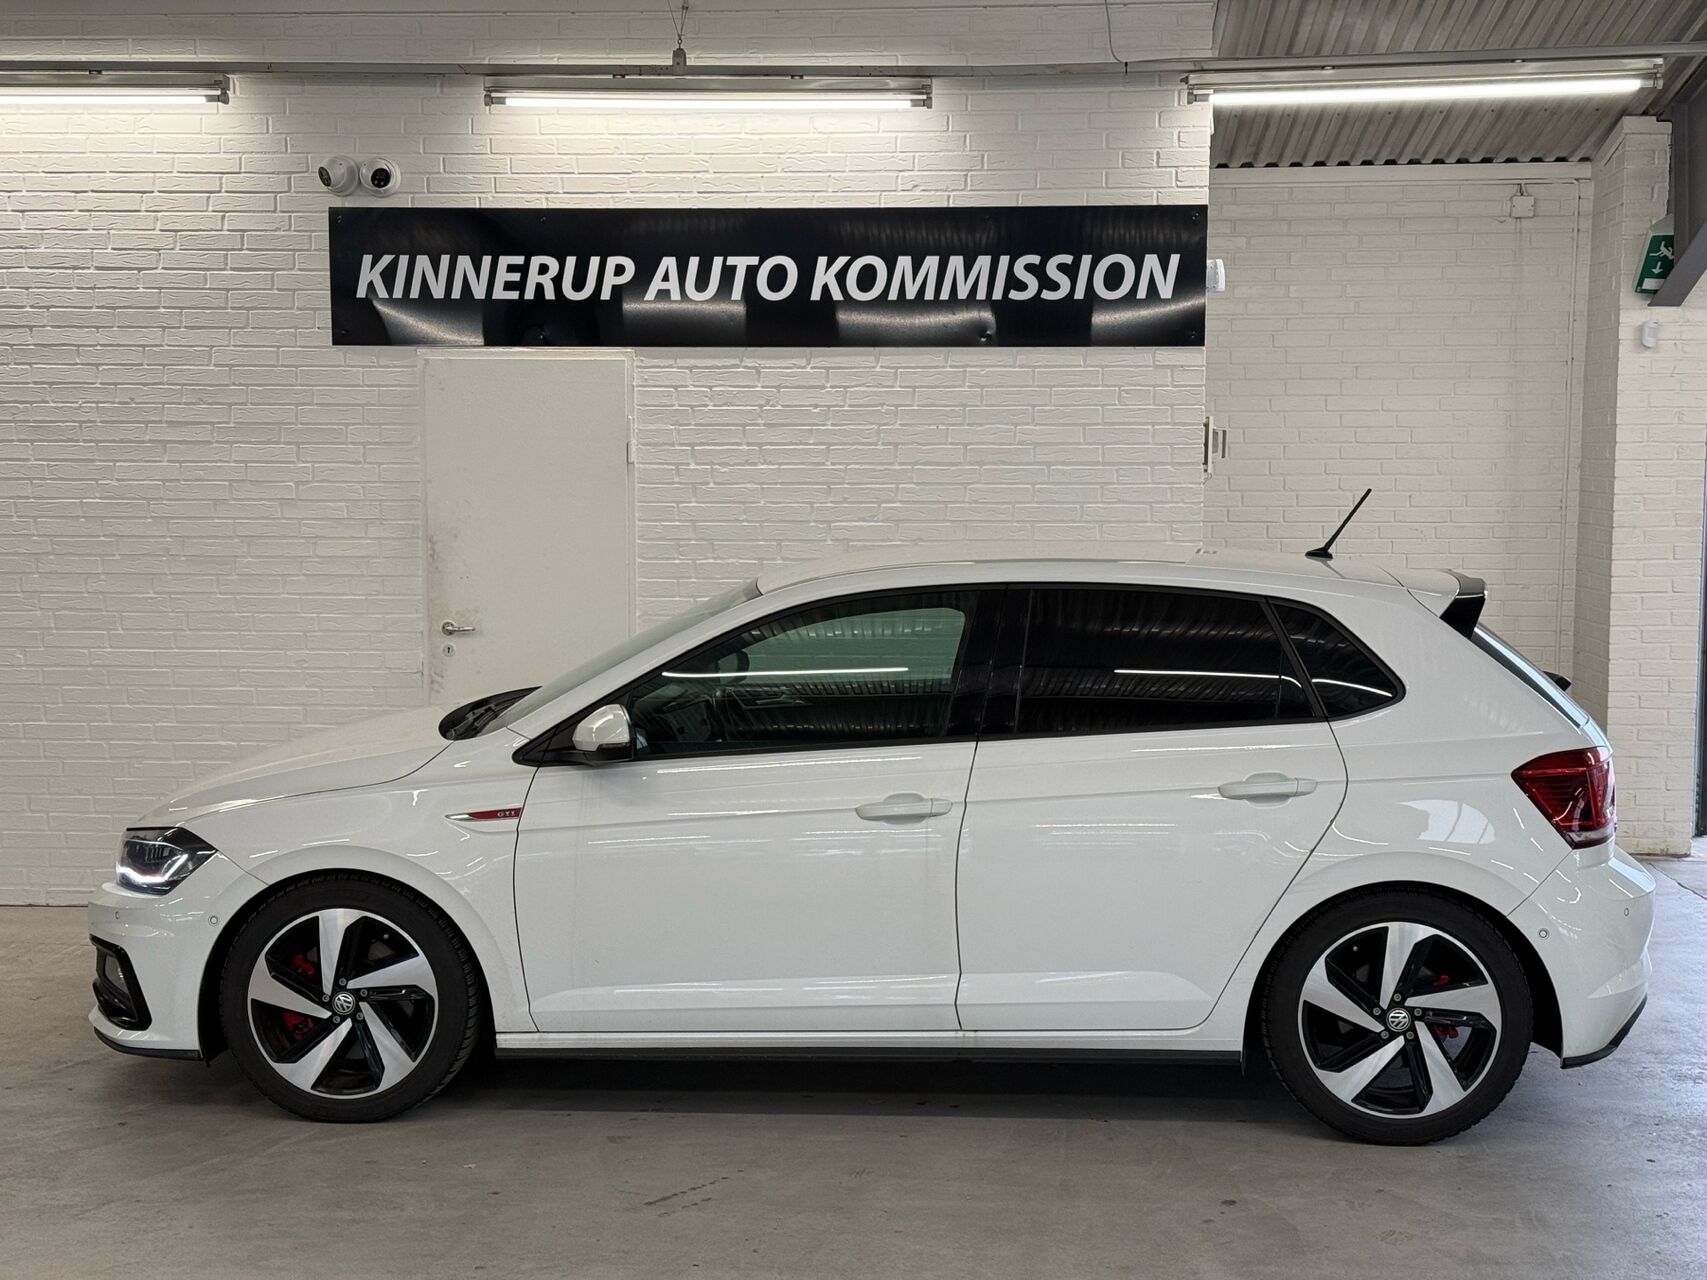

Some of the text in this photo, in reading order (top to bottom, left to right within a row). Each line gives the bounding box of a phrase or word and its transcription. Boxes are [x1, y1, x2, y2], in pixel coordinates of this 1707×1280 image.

[356, 253, 1181, 302] KINNERUP AUTO KOMMISSION
